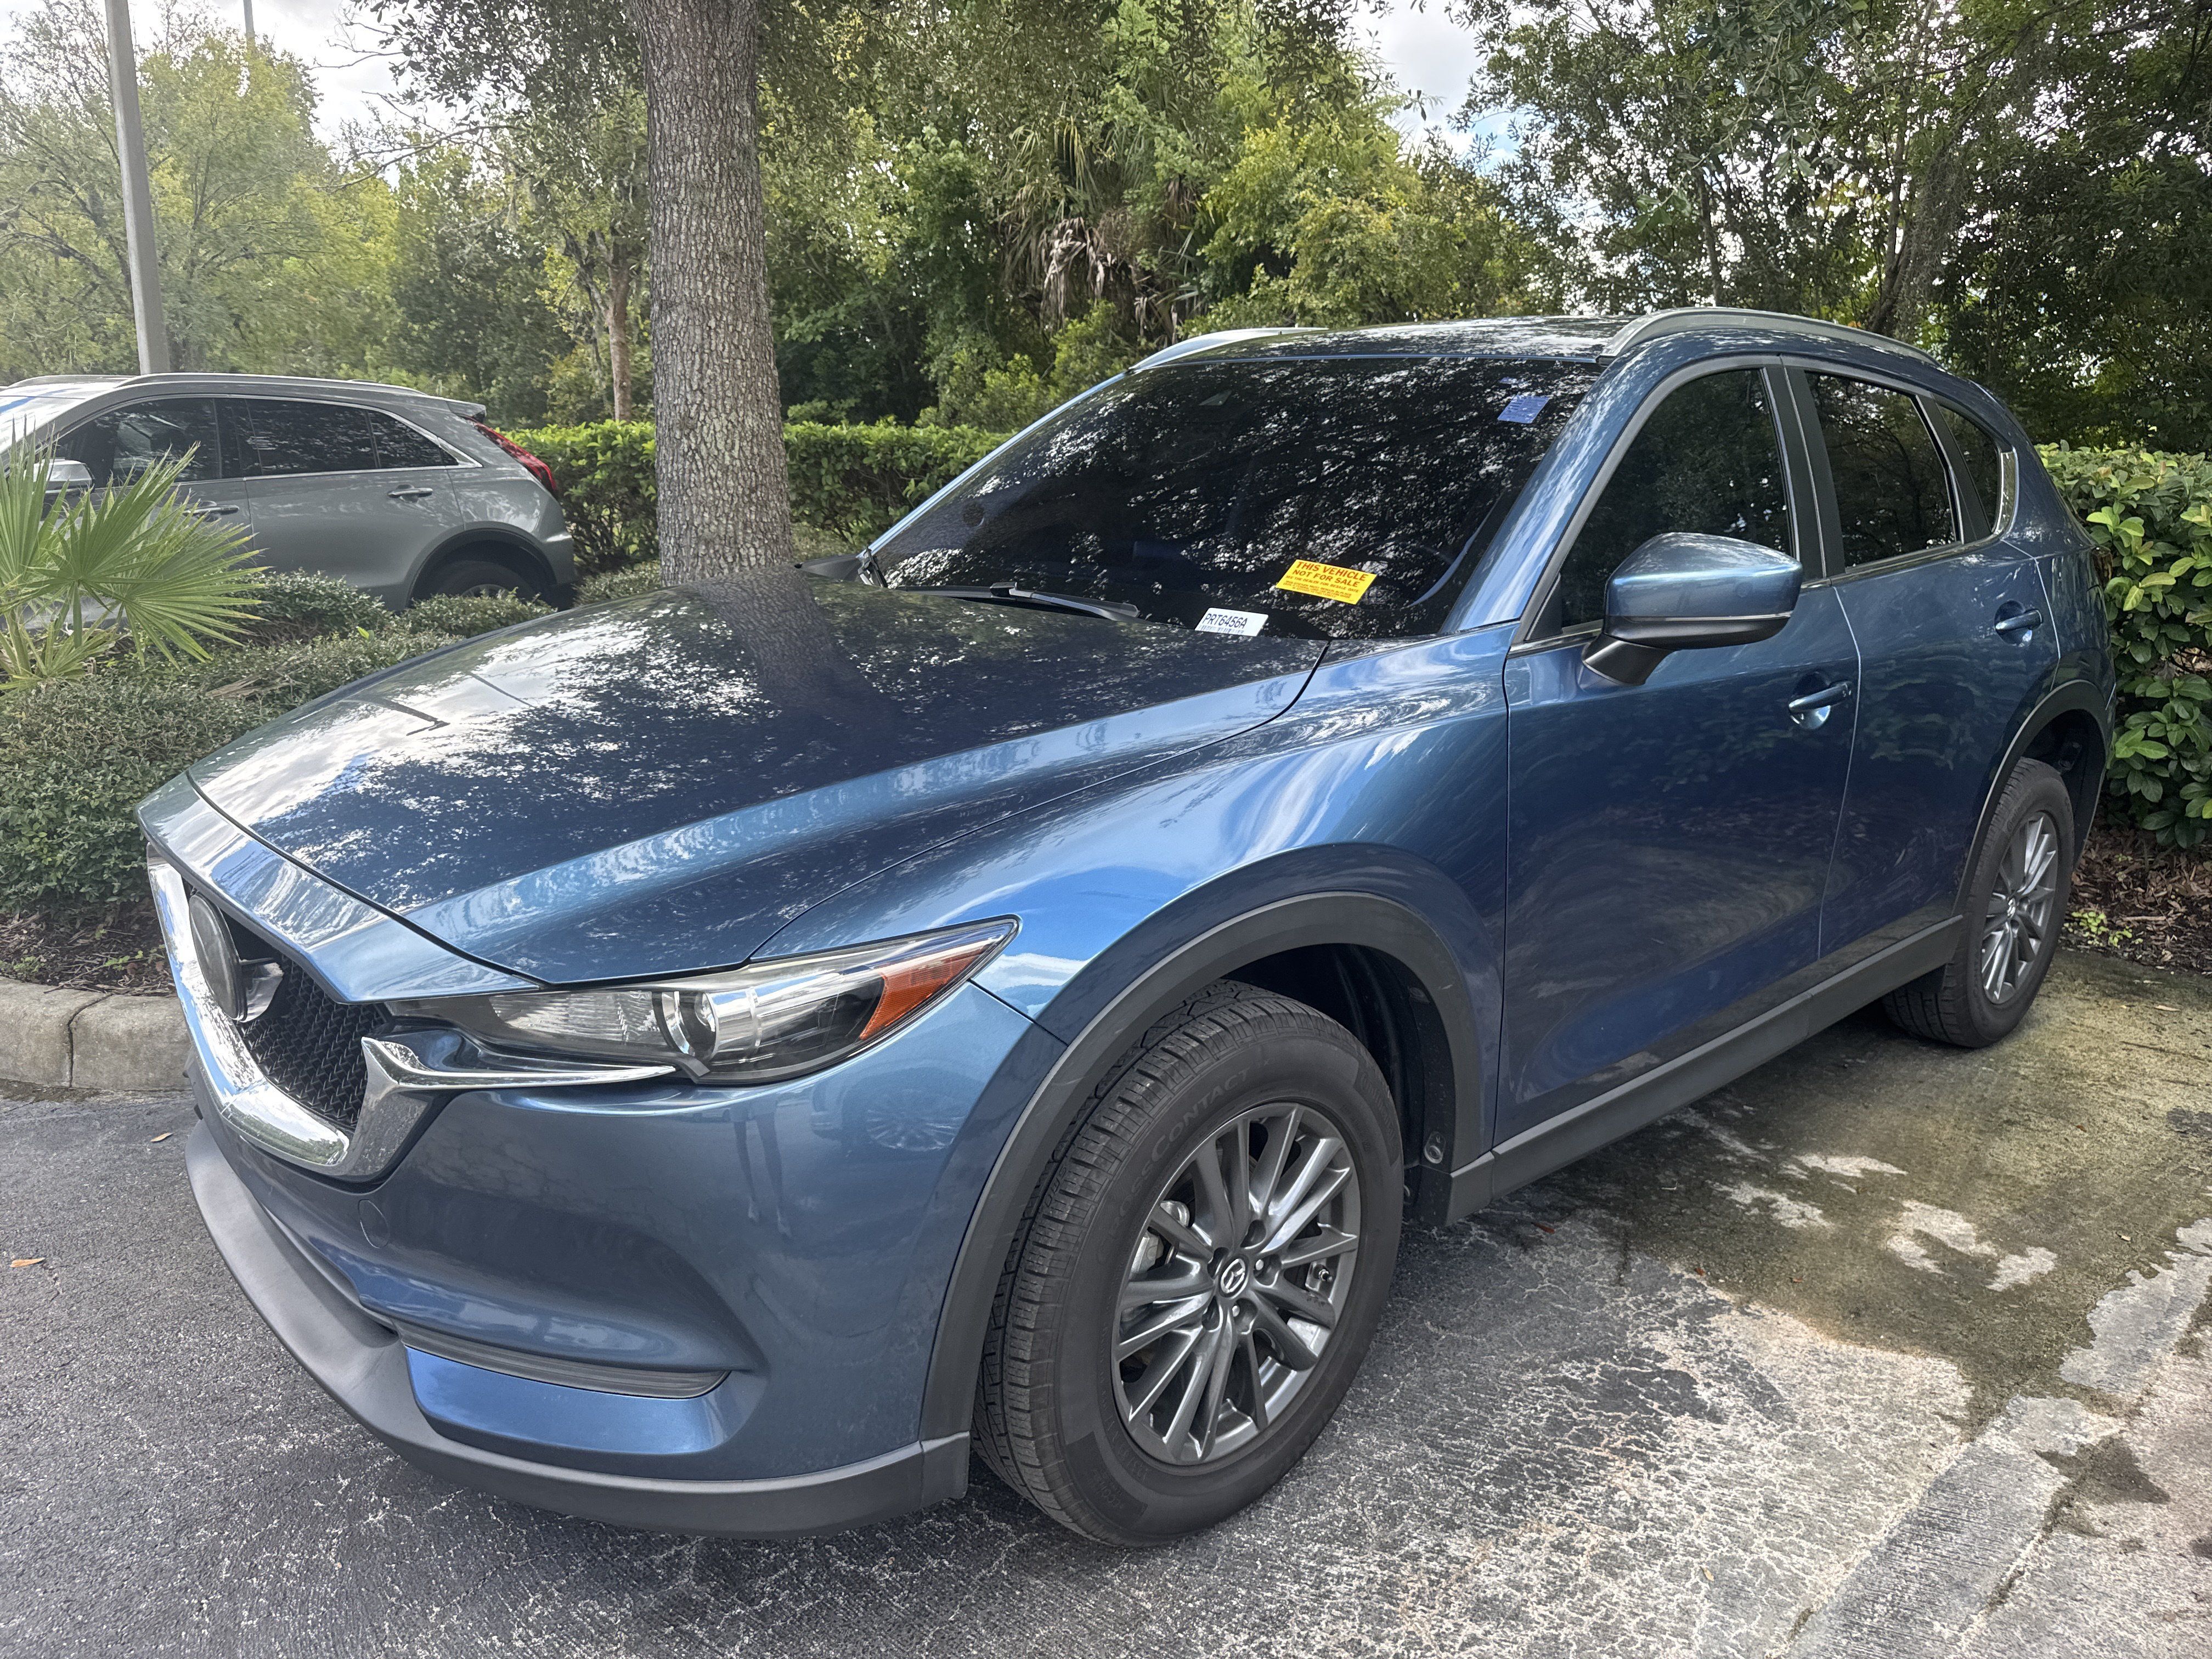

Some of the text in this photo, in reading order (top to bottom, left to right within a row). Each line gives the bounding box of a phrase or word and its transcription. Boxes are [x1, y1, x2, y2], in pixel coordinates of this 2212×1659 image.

[1296, 562, 1368, 581] THIS VEHICLE
[1313, 573, 1333, 582] FOR
[1334, 578, 1360, 588] SALE
[1202, 613, 1248, 629] PRT6456A
